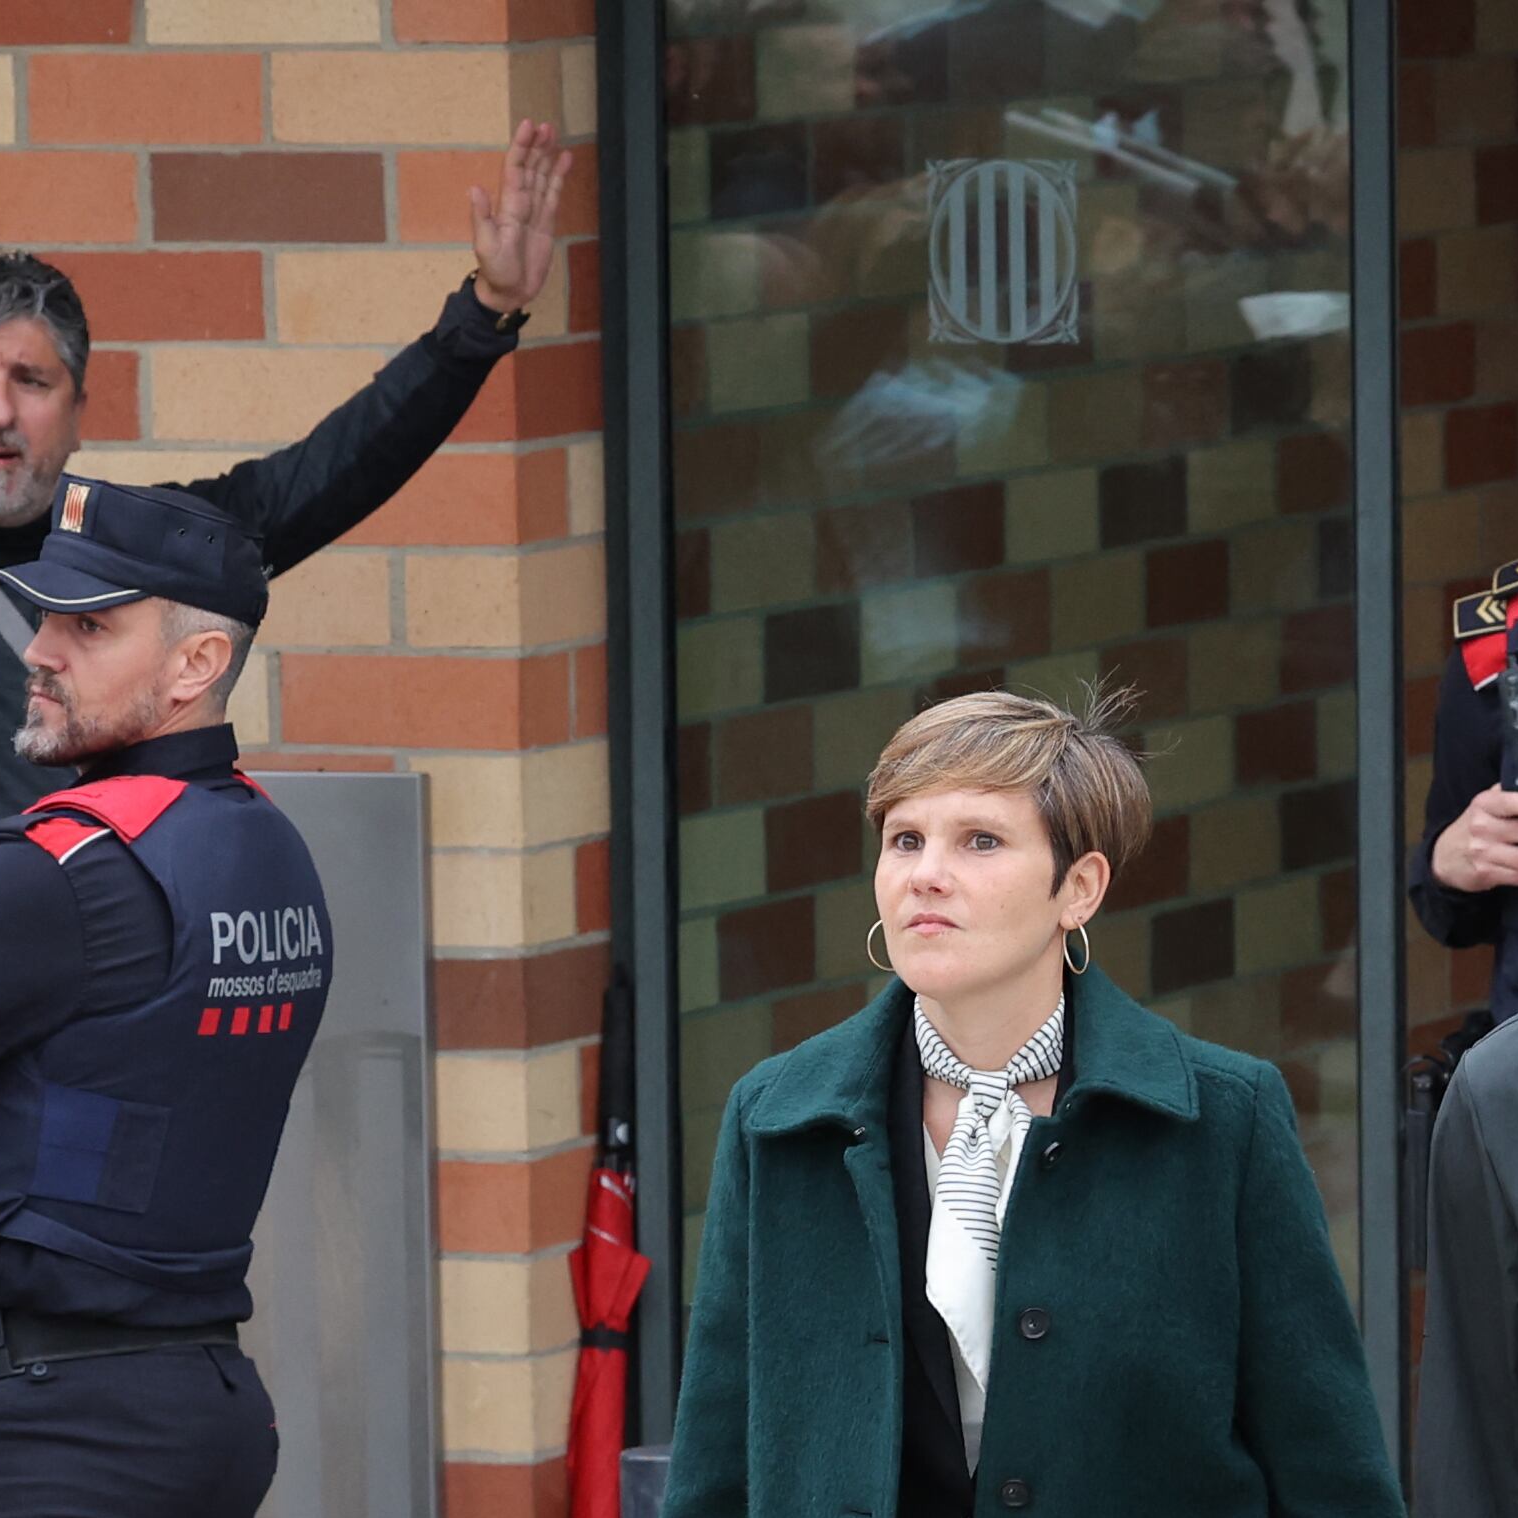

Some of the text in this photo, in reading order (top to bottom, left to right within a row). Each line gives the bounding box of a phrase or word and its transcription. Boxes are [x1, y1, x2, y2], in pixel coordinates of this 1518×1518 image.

[210, 905, 323, 965] POLICIA
[208, 963, 323, 998] mossos d'esquadra
